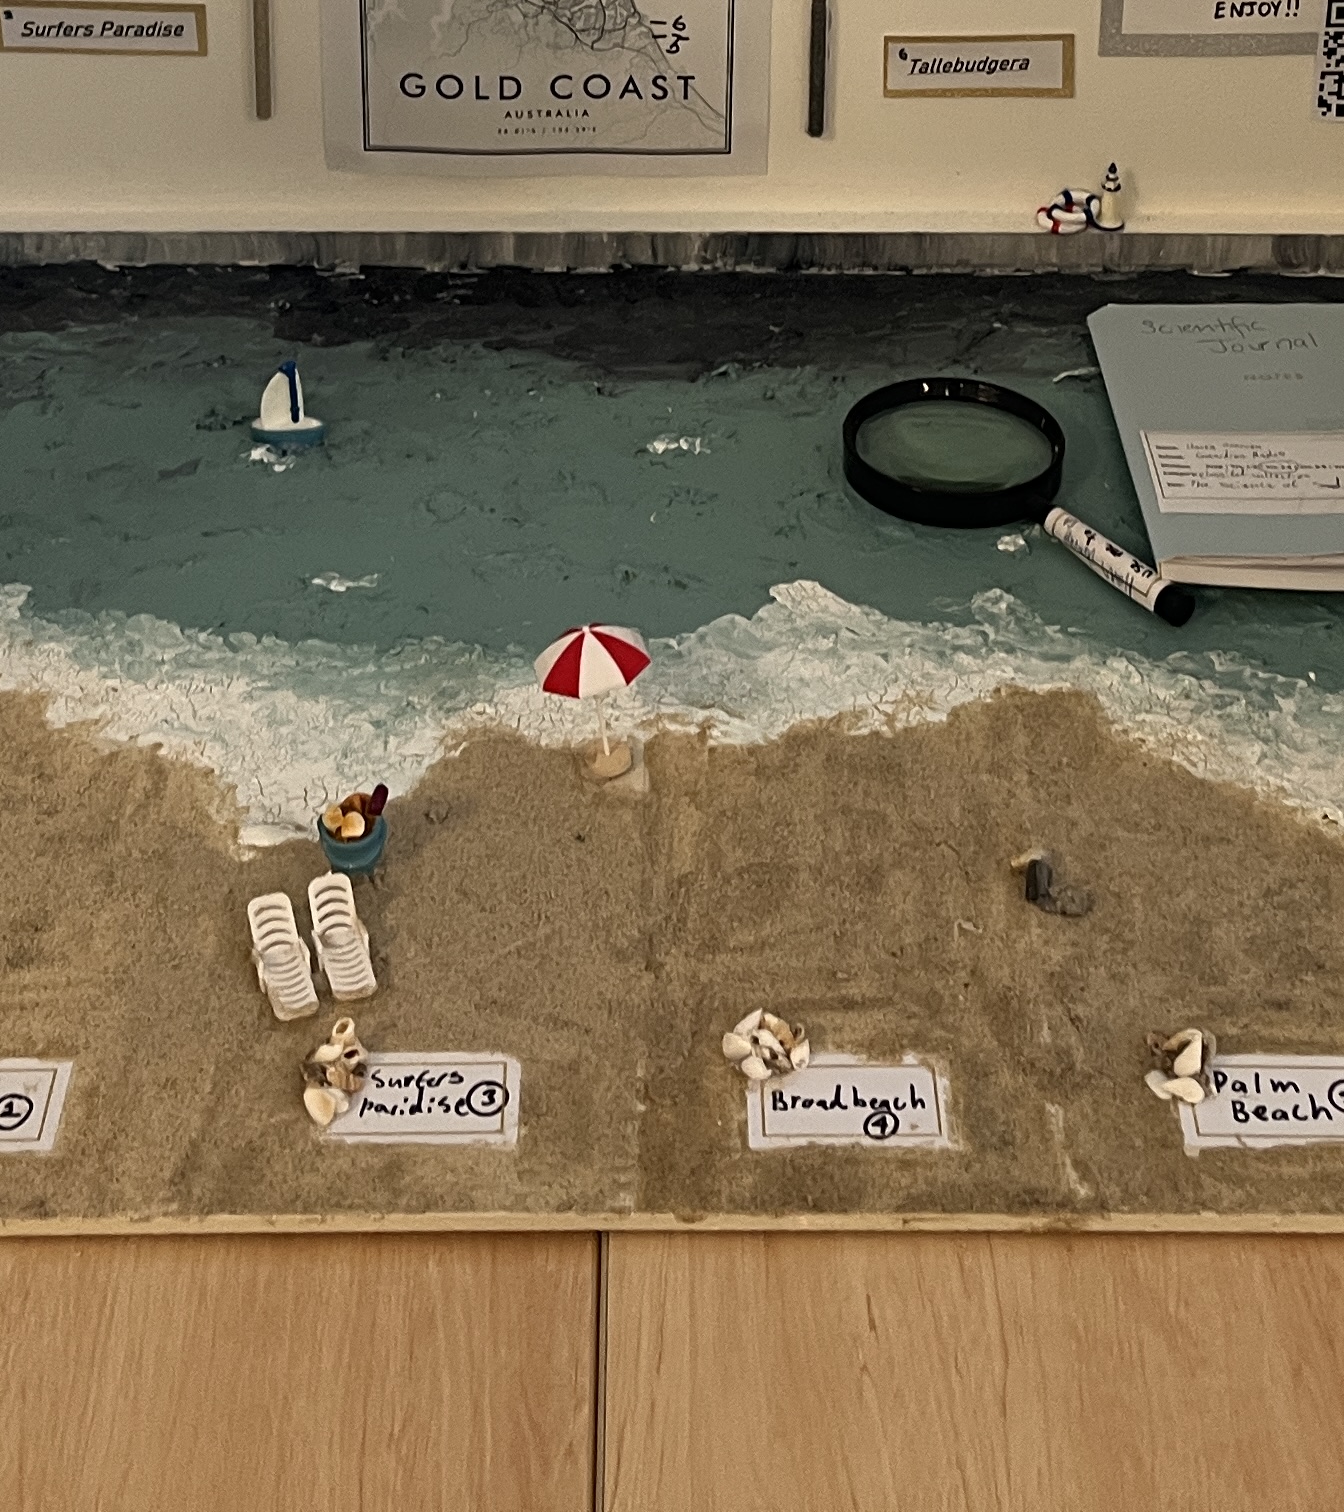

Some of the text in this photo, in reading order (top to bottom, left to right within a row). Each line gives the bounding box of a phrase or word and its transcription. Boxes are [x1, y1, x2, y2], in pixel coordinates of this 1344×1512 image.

[21, 21, 184, 37] Surfers Paradise
[672, 15, 686, 31] 6
[909, 56, 1031, 76] Tallebudgera
[400, 73, 695, 100] GOLD COAST
[505, 109, 589, 119] AUSTRALIA
[1196, 331, 1318, 354] Journal
[1213, 1070, 1300, 1094] Palm
[1232, 1093, 1333, 1123] Beach
